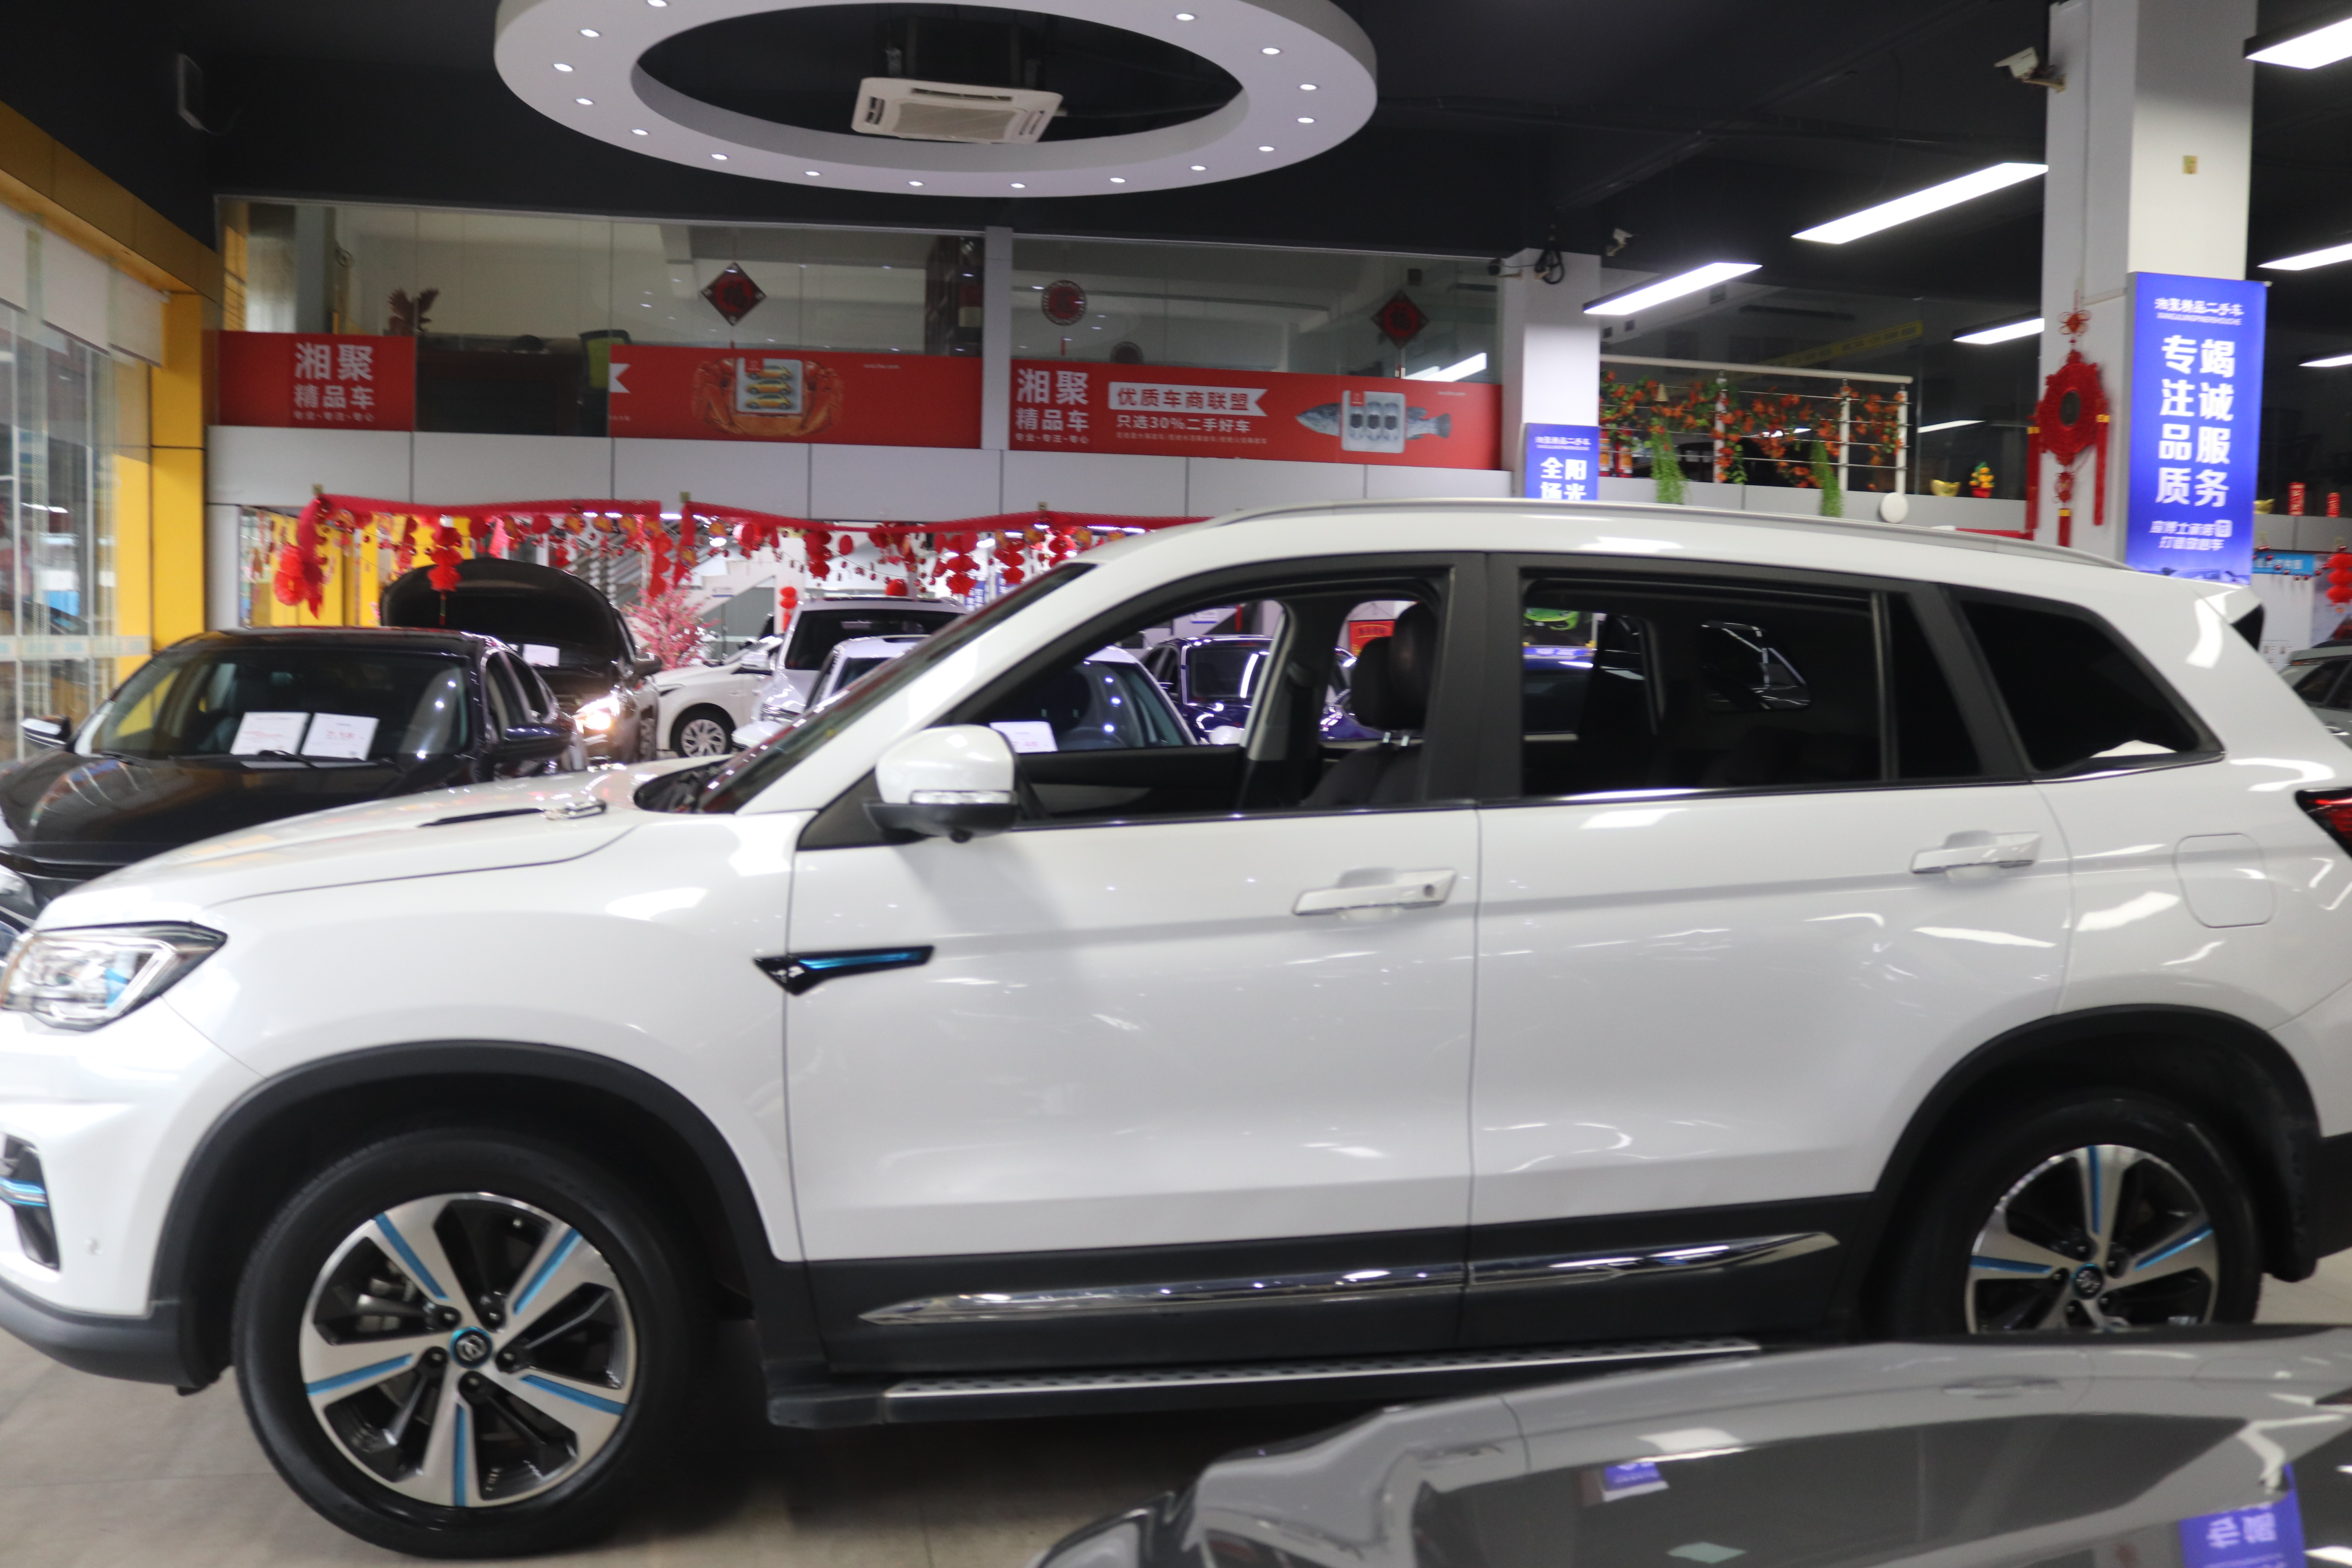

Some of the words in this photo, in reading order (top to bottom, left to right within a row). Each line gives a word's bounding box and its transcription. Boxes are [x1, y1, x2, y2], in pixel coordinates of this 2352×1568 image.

[295, 342, 374, 381] 湘聚
[294, 384, 375, 410] 精品车
[1017, 368, 1089, 405] 湘聚
[1117, 387, 1250, 411] 优质车商联盟
[1016, 408, 1090, 432] 精品车
[1116, 414, 1251, 433] 只选30%二手好车
[2155, 335, 2198, 505] 专注品质
[2194, 339, 2236, 508] 竭诚服务
